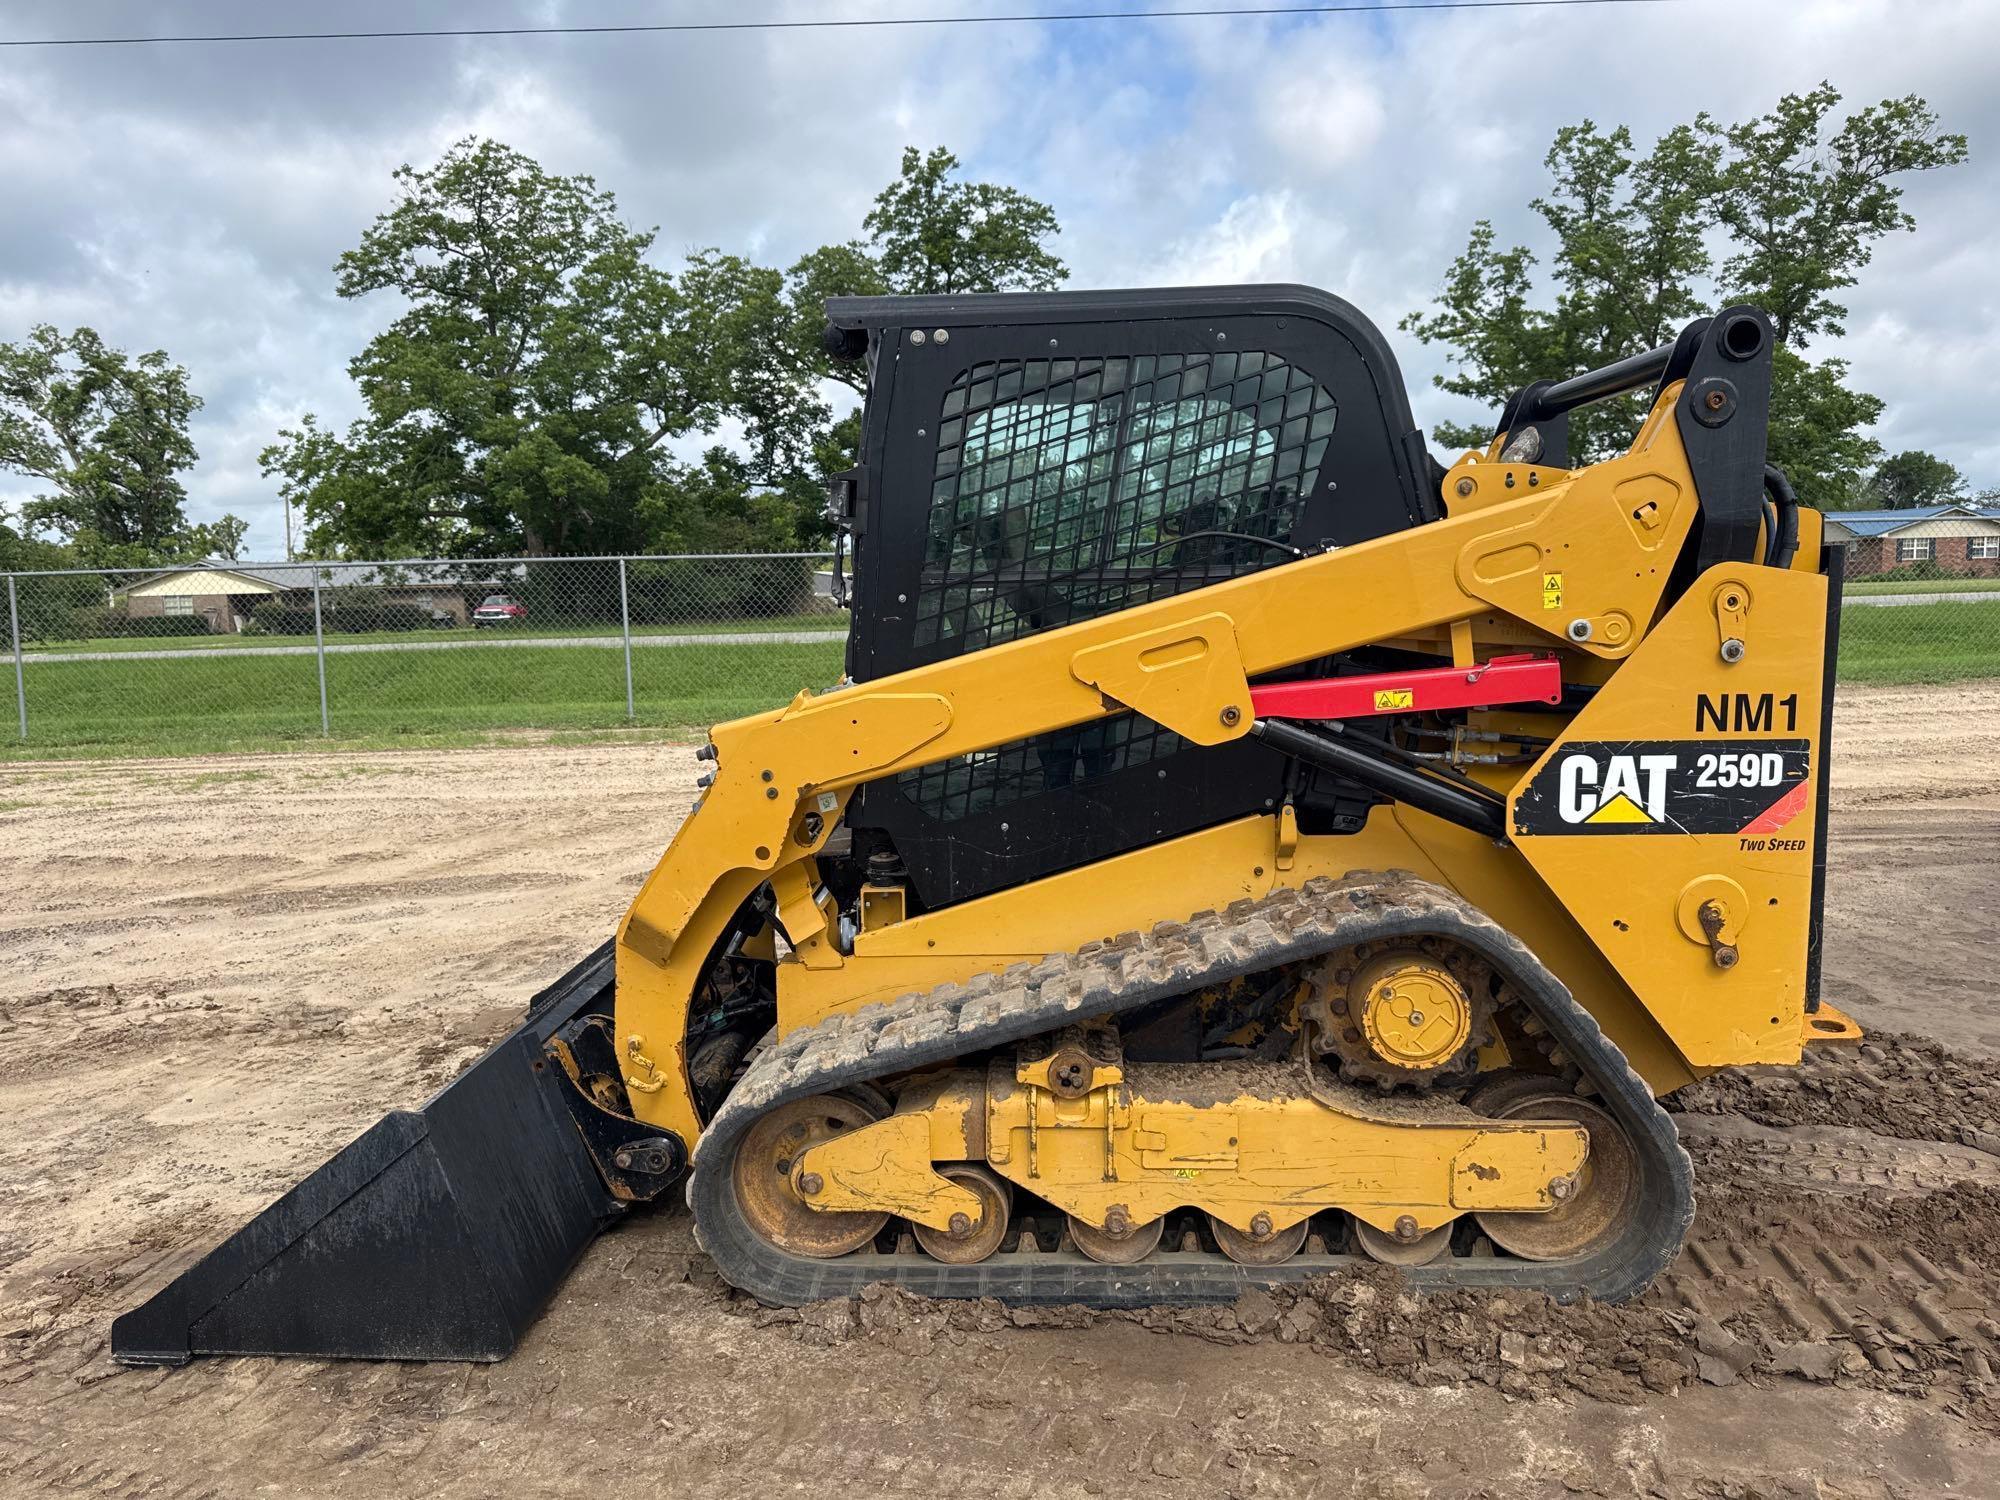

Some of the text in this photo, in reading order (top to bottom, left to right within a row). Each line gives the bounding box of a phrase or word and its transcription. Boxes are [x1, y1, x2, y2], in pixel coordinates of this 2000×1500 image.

[1695, 693, 1798, 732] NM1
[1559, 753, 1784, 824] CAT 259D
